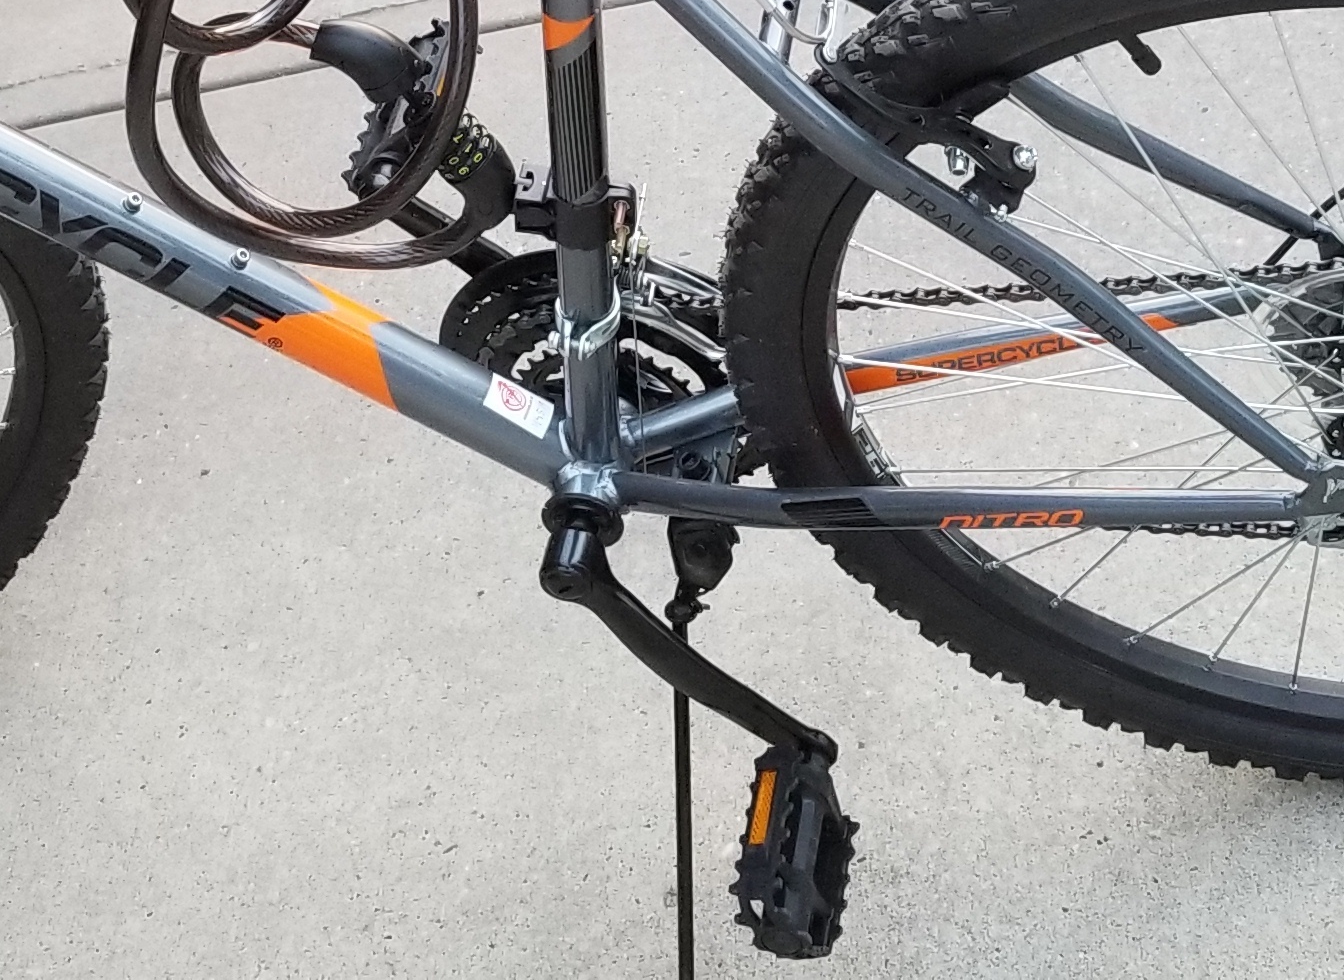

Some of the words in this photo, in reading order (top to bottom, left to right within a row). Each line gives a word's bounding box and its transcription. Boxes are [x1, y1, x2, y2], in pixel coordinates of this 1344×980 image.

[903, 187, 977, 244] TRAIL
[990, 243, 1144, 353] GEOMETRY
[938, 508, 1084, 529] NITRO
